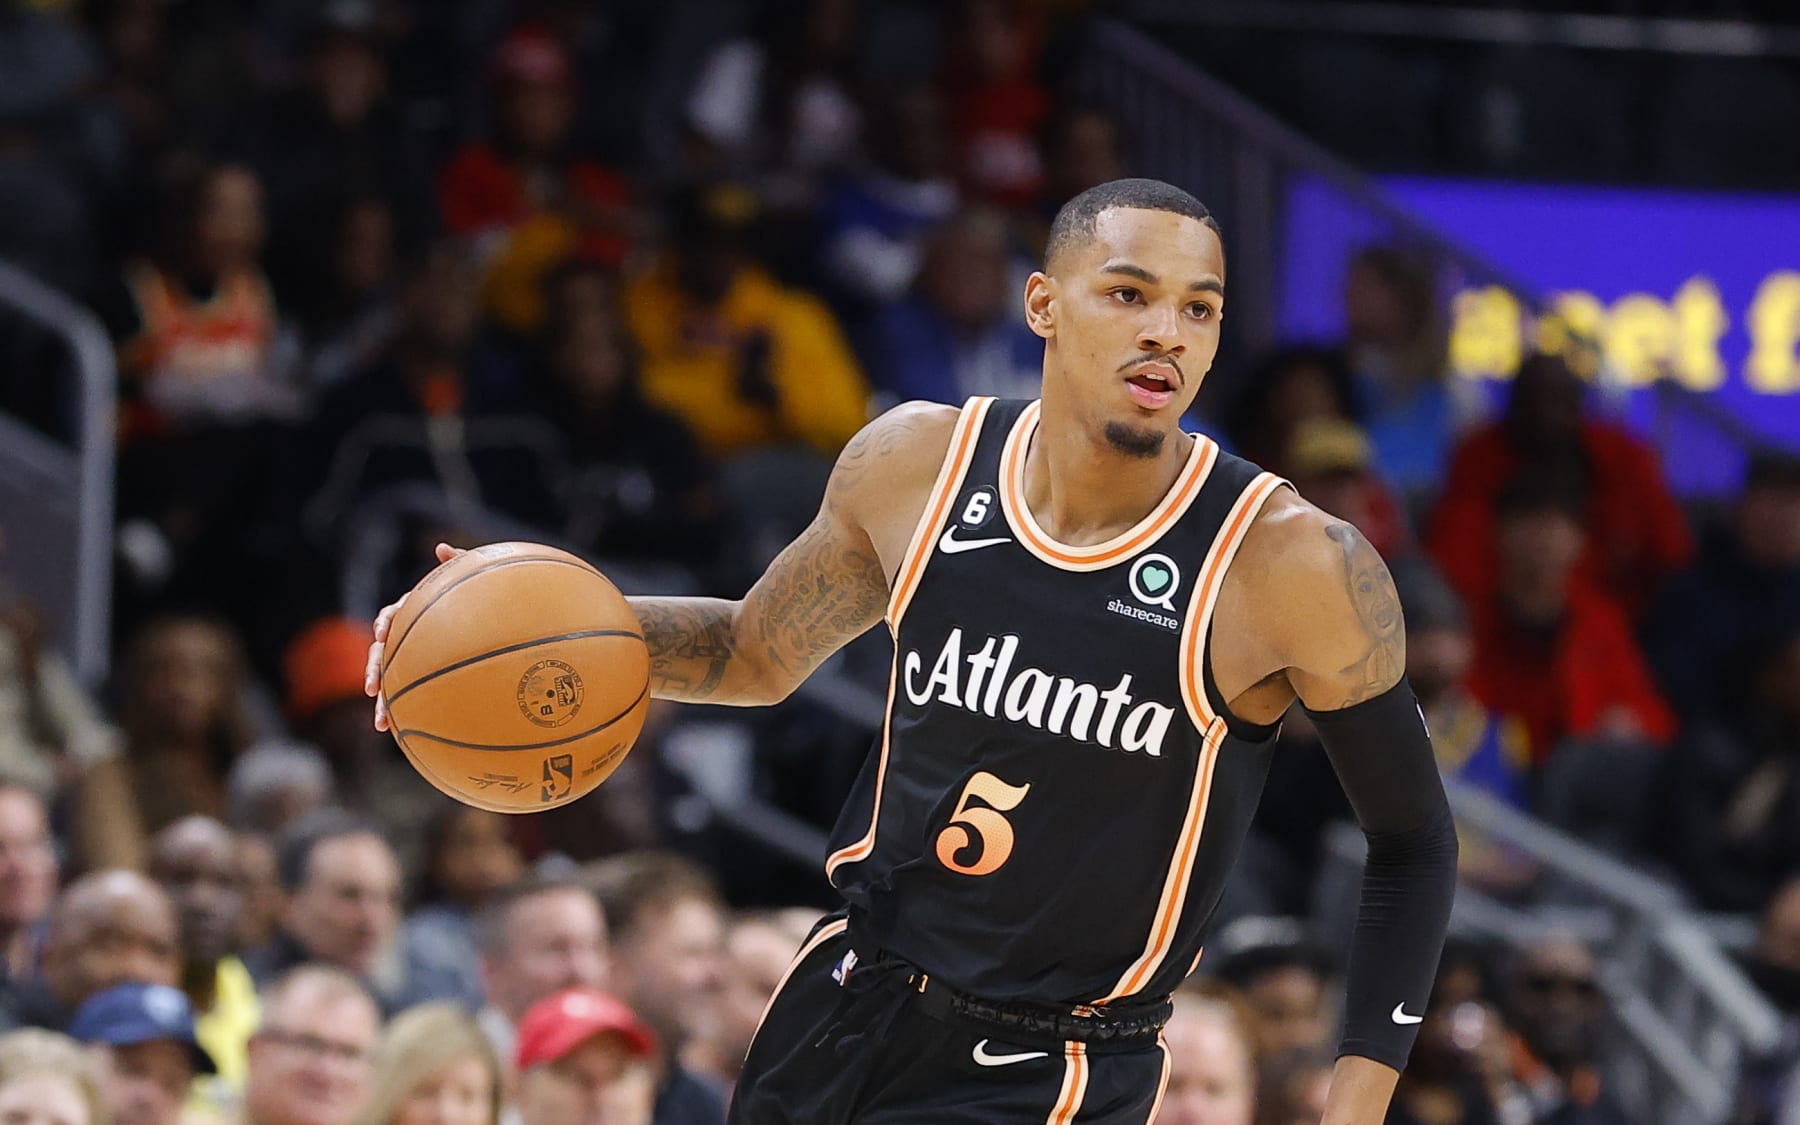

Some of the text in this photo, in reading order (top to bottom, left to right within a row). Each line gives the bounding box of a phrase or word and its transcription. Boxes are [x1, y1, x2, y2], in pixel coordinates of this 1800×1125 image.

[962, 491, 991, 525] 6
[1106, 599, 1179, 630] sharecare
[904, 628, 1176, 757] Atlanta
[935, 771, 1031, 876] 5
